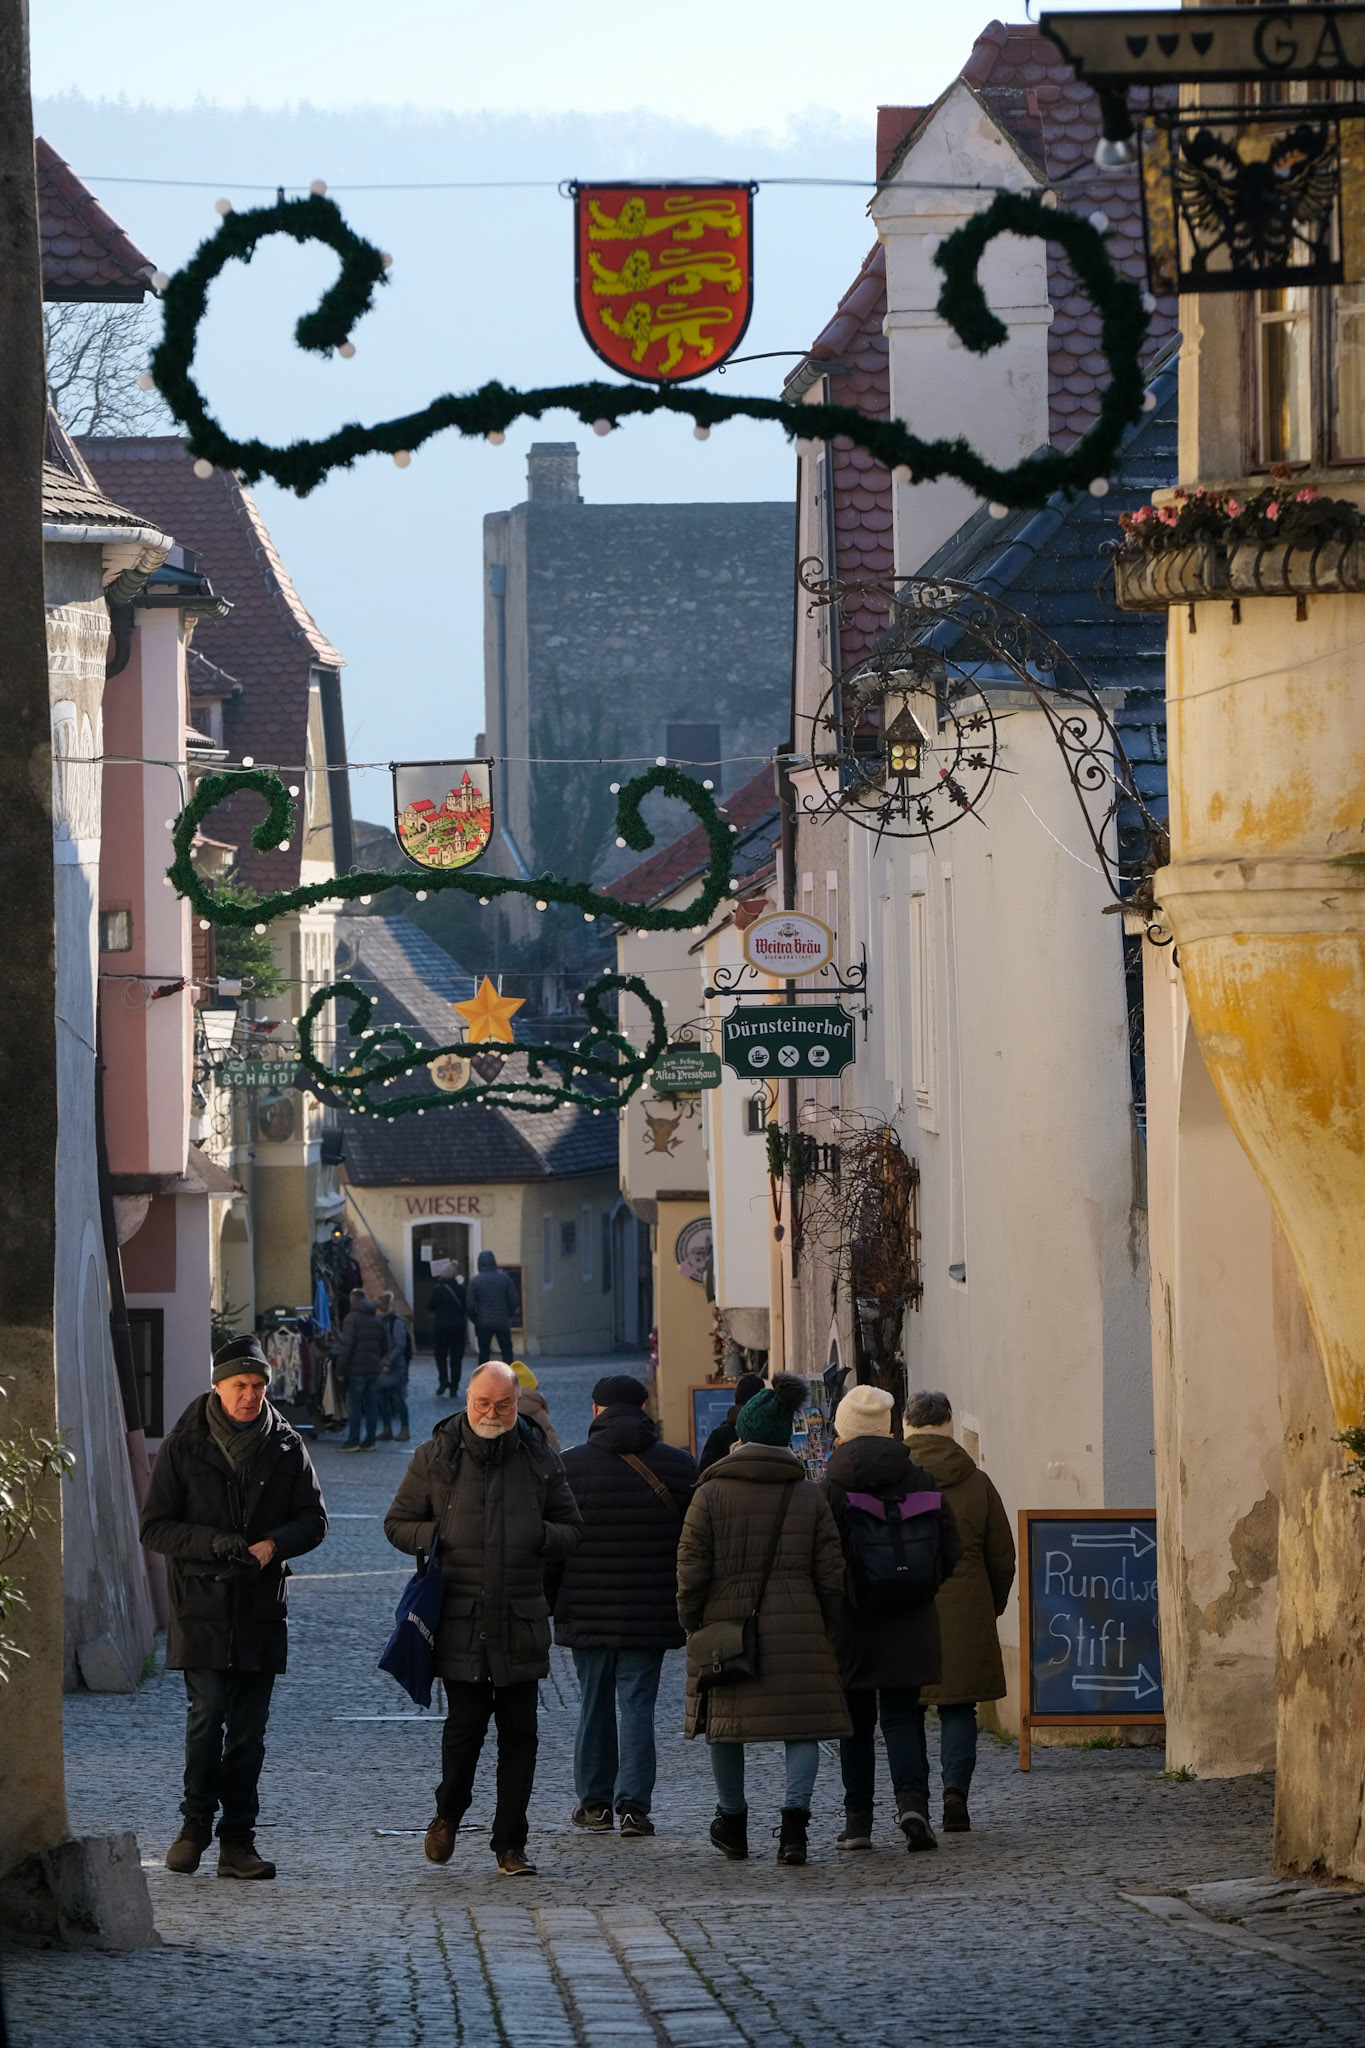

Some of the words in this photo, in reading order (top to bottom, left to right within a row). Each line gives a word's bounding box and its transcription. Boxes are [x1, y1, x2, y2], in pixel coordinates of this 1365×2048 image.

[1253, 14, 1365, 69] GA
[755, 938, 793, 954] Weitra
[794, 938, 821, 954] Bräu
[726, 1016, 851, 1041] Dürnsteinerhof
[655, 1069, 676, 1080] Altes
[676, 1067, 717, 1081] Presshaus
[405, 1196, 481, 1214] WIESER
[1045, 1550, 1159, 1628] Rundwe
[1048, 1612, 1127, 1668] Stift
